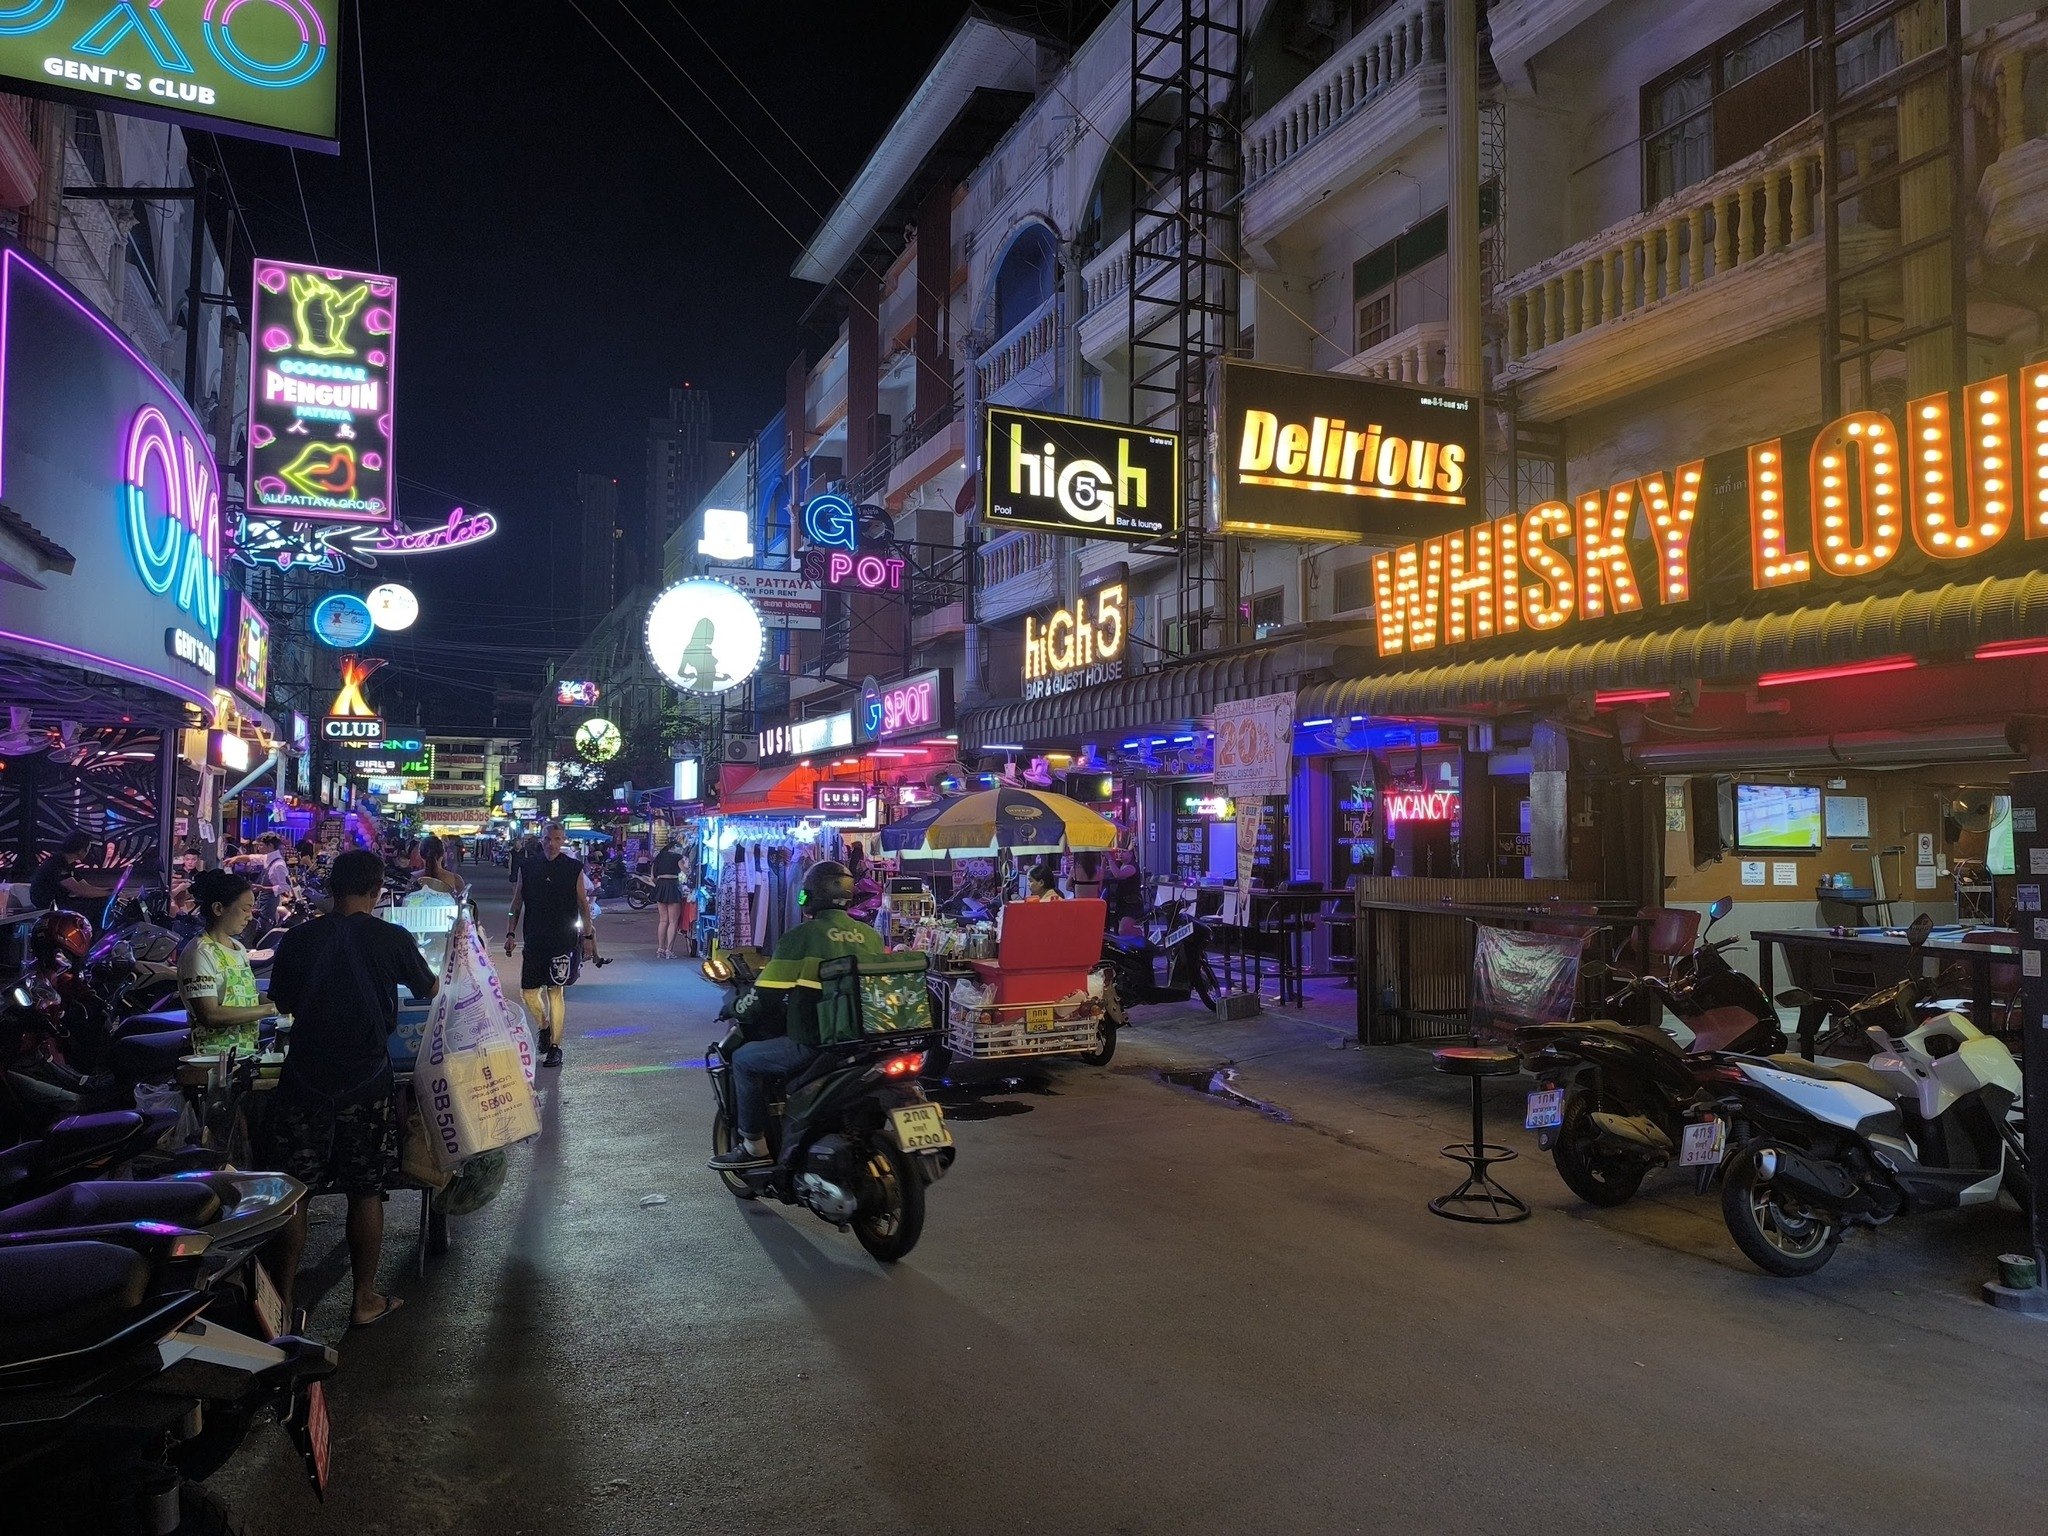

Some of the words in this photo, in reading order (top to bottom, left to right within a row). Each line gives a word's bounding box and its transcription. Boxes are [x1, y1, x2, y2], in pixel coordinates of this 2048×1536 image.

[43, 57, 142, 91] GENT'S
[148, 77, 216, 105] CLUB
[266, 369, 378, 410] PENGUIN
[296, 406, 352, 421] PATTAYA
[1237, 409, 1467, 493] Delirious
[338, 498, 380, 510] GROUP
[994, 504, 1012, 516] Pool
[805, 494, 855, 551] G
[1116, 516, 1129, 528] Bar
[1130, 518, 1137, 527] &
[1138, 519, 1163, 531] lounge
[1371, 458, 1705, 657] WHISKY
[804, 550, 905, 589] SPOT
[756, 577, 814, 590] PATTAYA
[759, 588, 775, 596] FOR
[1097, 584, 1123, 657] 5
[1025, 682, 1044, 701] BAR
[1044, 678, 1052, 696] &
[1053, 669, 1084, 695] GUEST
[1086, 661, 1123, 688] HOUSE
[884, 683, 930, 730] SPOT
[325, 721, 381, 737] CLUB
[824, 793, 860, 803] LUSH
[1387, 793, 1450, 821] VACANCY
[827, 927, 865, 944] Grab
[430, 1077, 460, 1154] SB500
[908, 1133, 940, 1147] 6700
[1686, 1150, 1714, 1162] 3140
